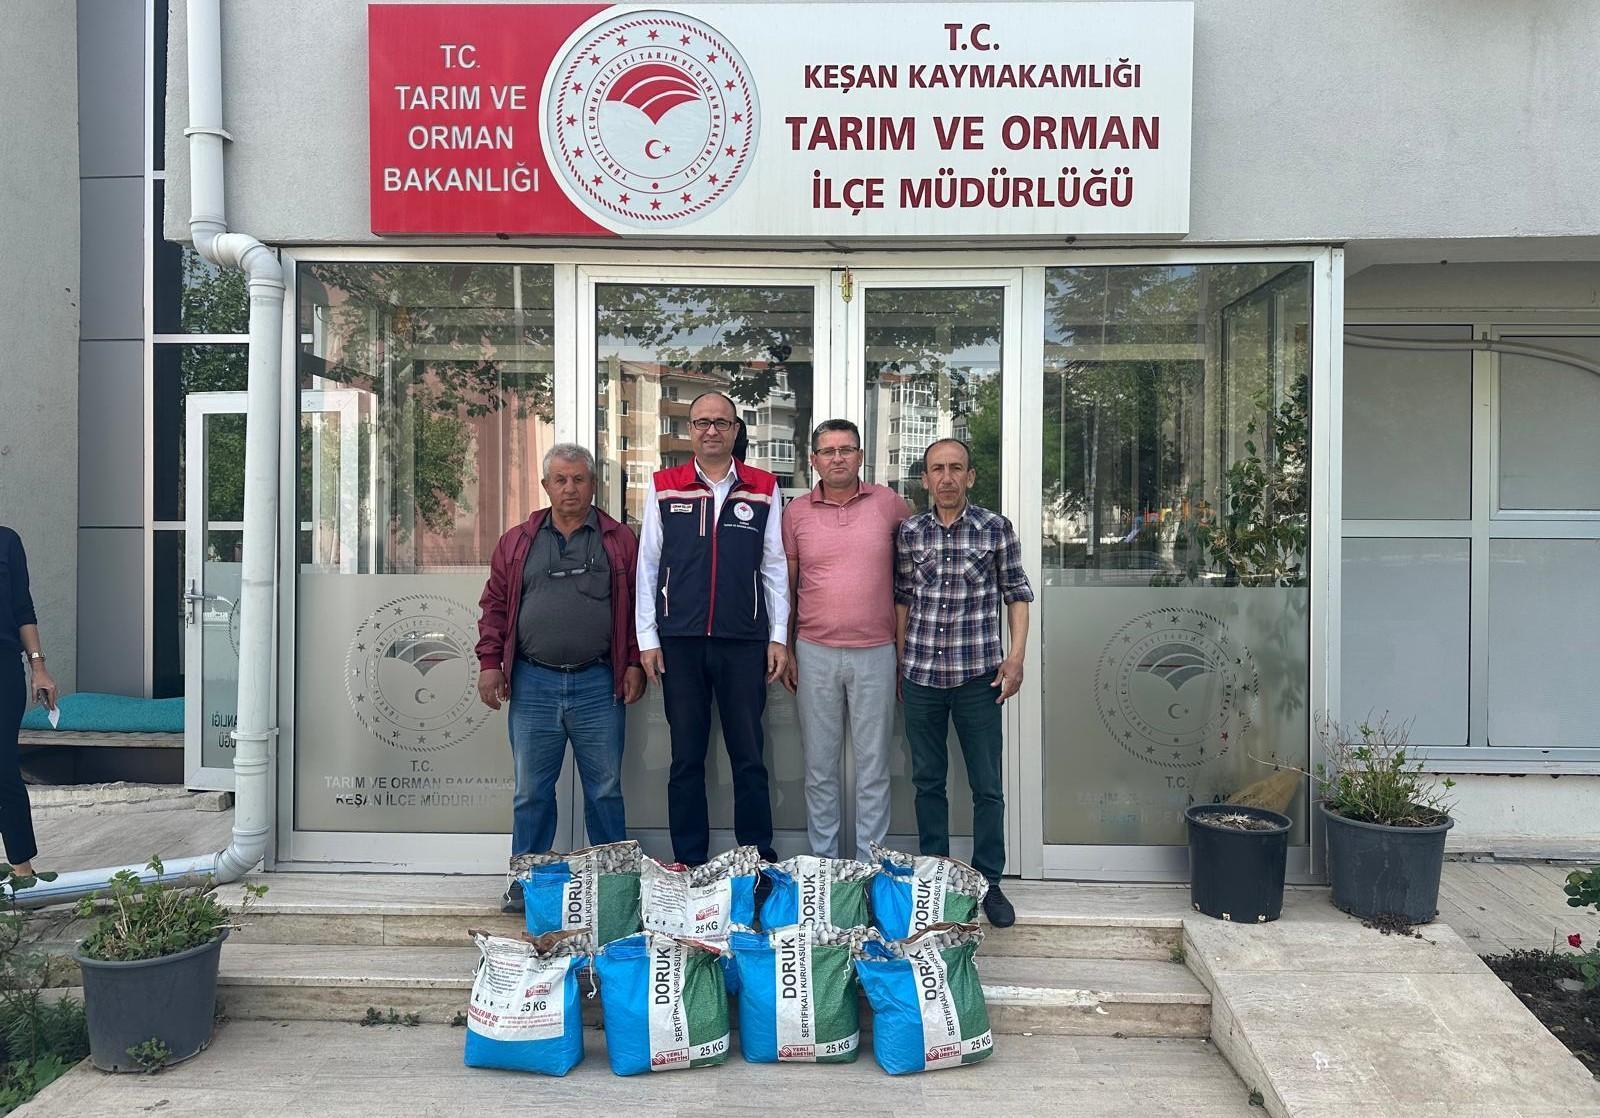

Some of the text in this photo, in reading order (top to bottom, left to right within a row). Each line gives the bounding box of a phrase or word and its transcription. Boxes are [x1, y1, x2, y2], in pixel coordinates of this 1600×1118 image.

[944, 23, 1000, 51] T.C.
[440, 45, 480, 69] T.C.
[804, 57, 1142, 94] KEŞAN KAYMAKAMLIĞI
[395, 86, 527, 110] TARIM VE
[408, 125, 514, 150] ORMAN
[785, 115, 1160, 151] TARIM VE ORMAN
[384, 161, 540, 193] BAKANLIĞI
[812, 166, 1134, 216] İLÇE MÜDÜRLÜĞÜ
[410, 760, 433, 772] T.C.
[391, 776, 441, 790] ORMAN
[568, 870, 582, 924] DORUK
[695, 920, 718, 934] 25 KG
[782, 938, 797, 999] DORUK
[799, 933, 808, 989] KURUFASULYE
[655, 947, 671, 1005] DORUK
[520, 1000, 547, 1012] 25 KG
[800, 990, 810, 1038] SERTİFİKALI
[700, 1040, 724, 1057] 25 KG
[825, 1040, 850, 1054] 25 KG
[971, 1035, 991, 1051] 25 KG
